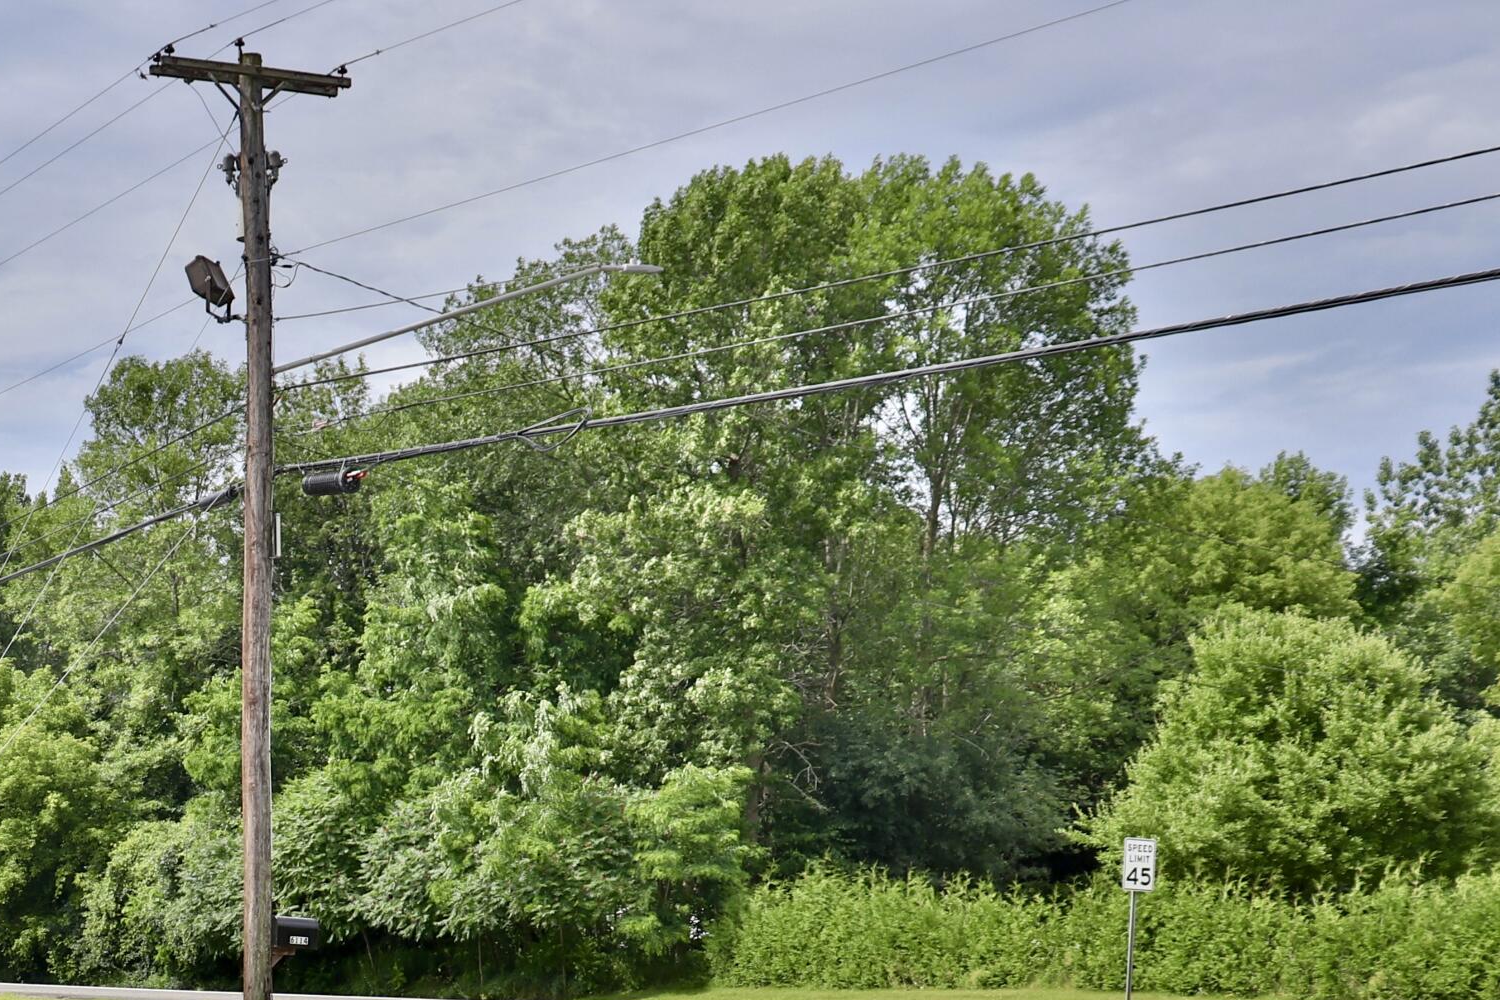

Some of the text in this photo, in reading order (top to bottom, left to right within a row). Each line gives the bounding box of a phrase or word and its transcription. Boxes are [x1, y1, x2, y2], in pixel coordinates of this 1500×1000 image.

[1128, 844, 1153, 853] SPEED
[1129, 855, 1150, 863] LIMIT
[1126, 867, 1151, 886] 45
[290, 936, 308, 944] 6114
